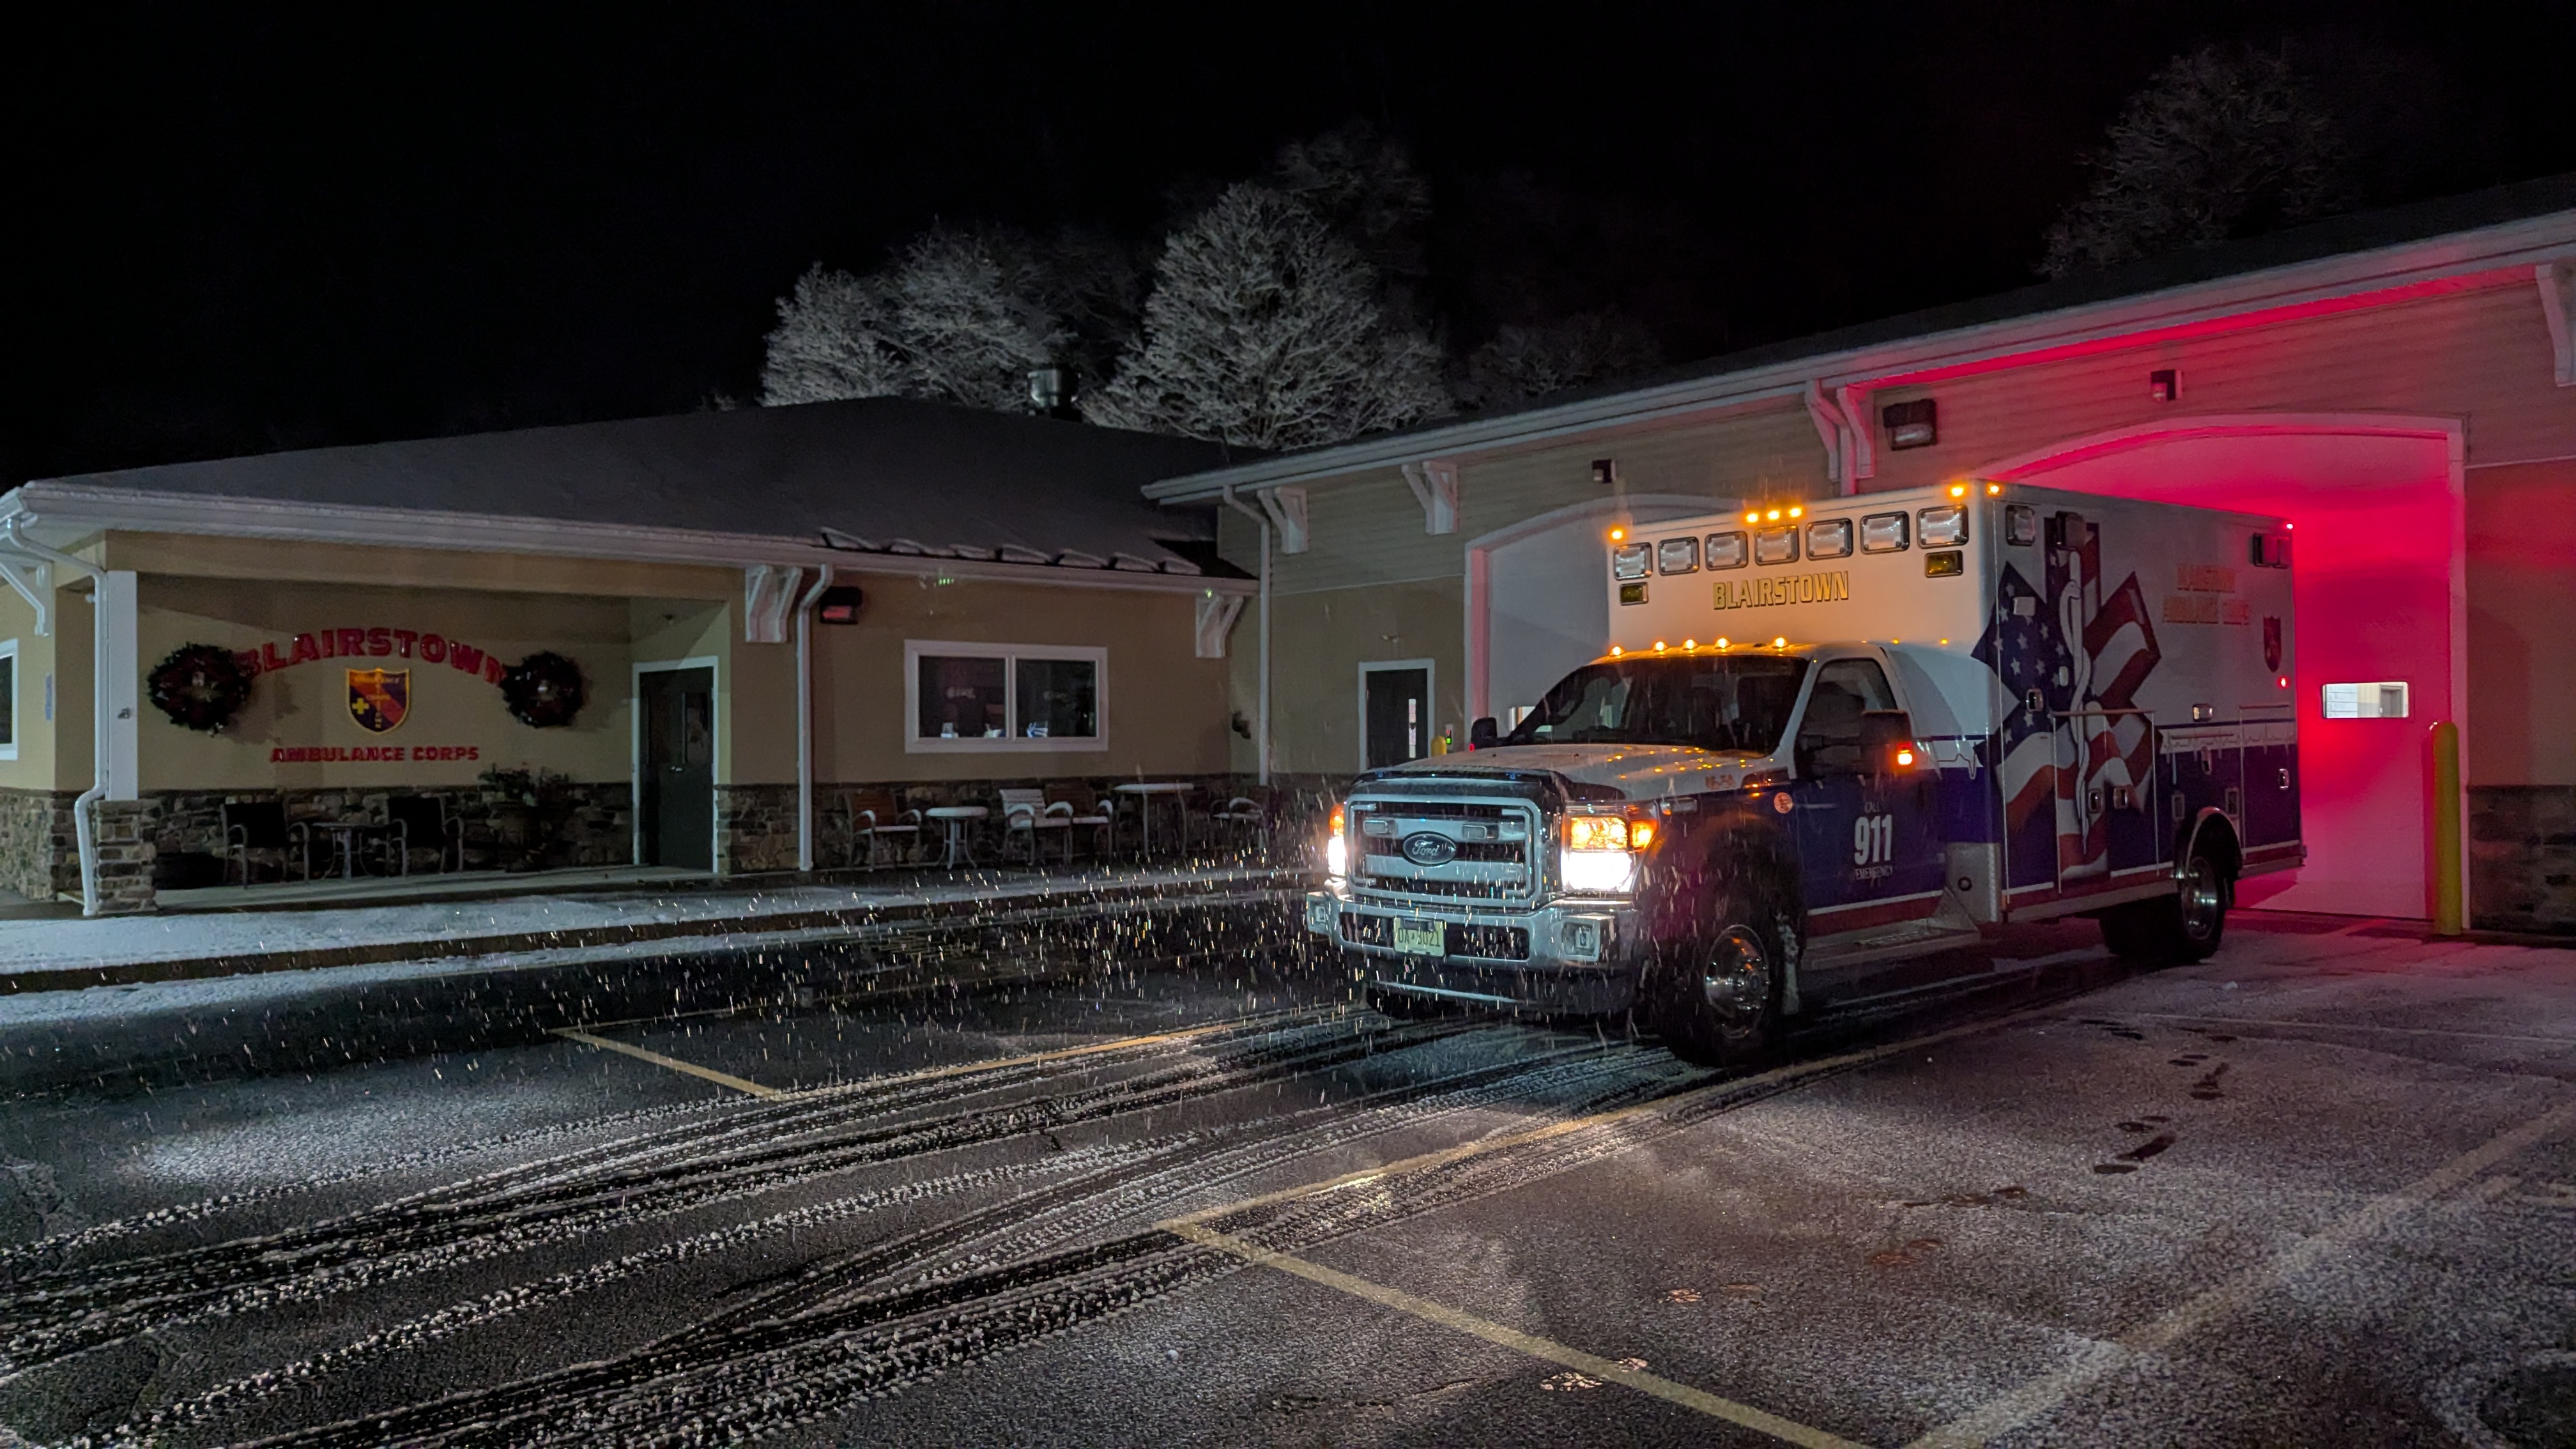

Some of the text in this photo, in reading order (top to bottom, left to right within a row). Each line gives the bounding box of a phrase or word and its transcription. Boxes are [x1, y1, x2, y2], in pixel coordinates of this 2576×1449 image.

[1713, 571, 1849, 610] BLAIRSTOWN
[271, 746, 479, 763] AMBULANCE CORPS
[1412, 839, 1440, 855] Ford
[1854, 814, 1892, 865] 911
